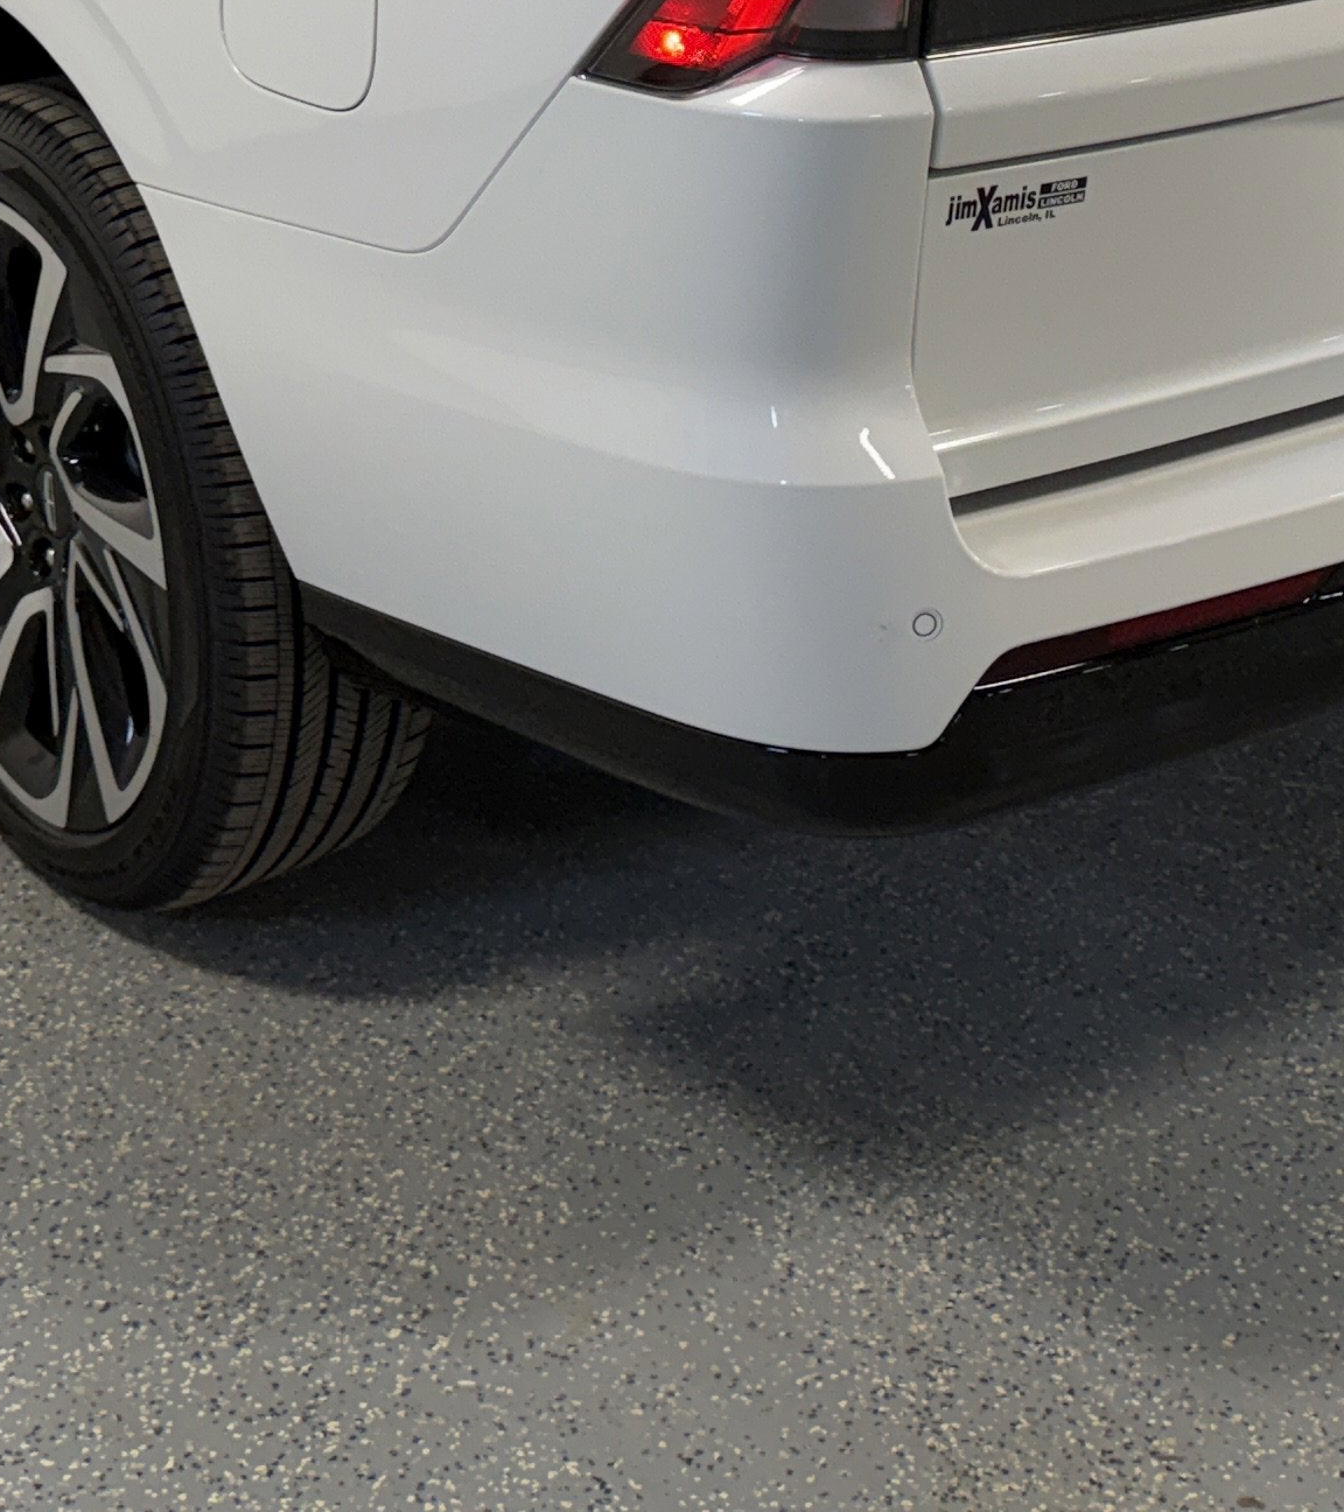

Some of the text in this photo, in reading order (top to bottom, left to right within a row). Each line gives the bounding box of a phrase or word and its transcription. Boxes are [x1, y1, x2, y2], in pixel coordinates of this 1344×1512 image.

[1040, 191, 1085, 207] LINCOLN
[997, 209, 1056, 227] Lincoln, IL
